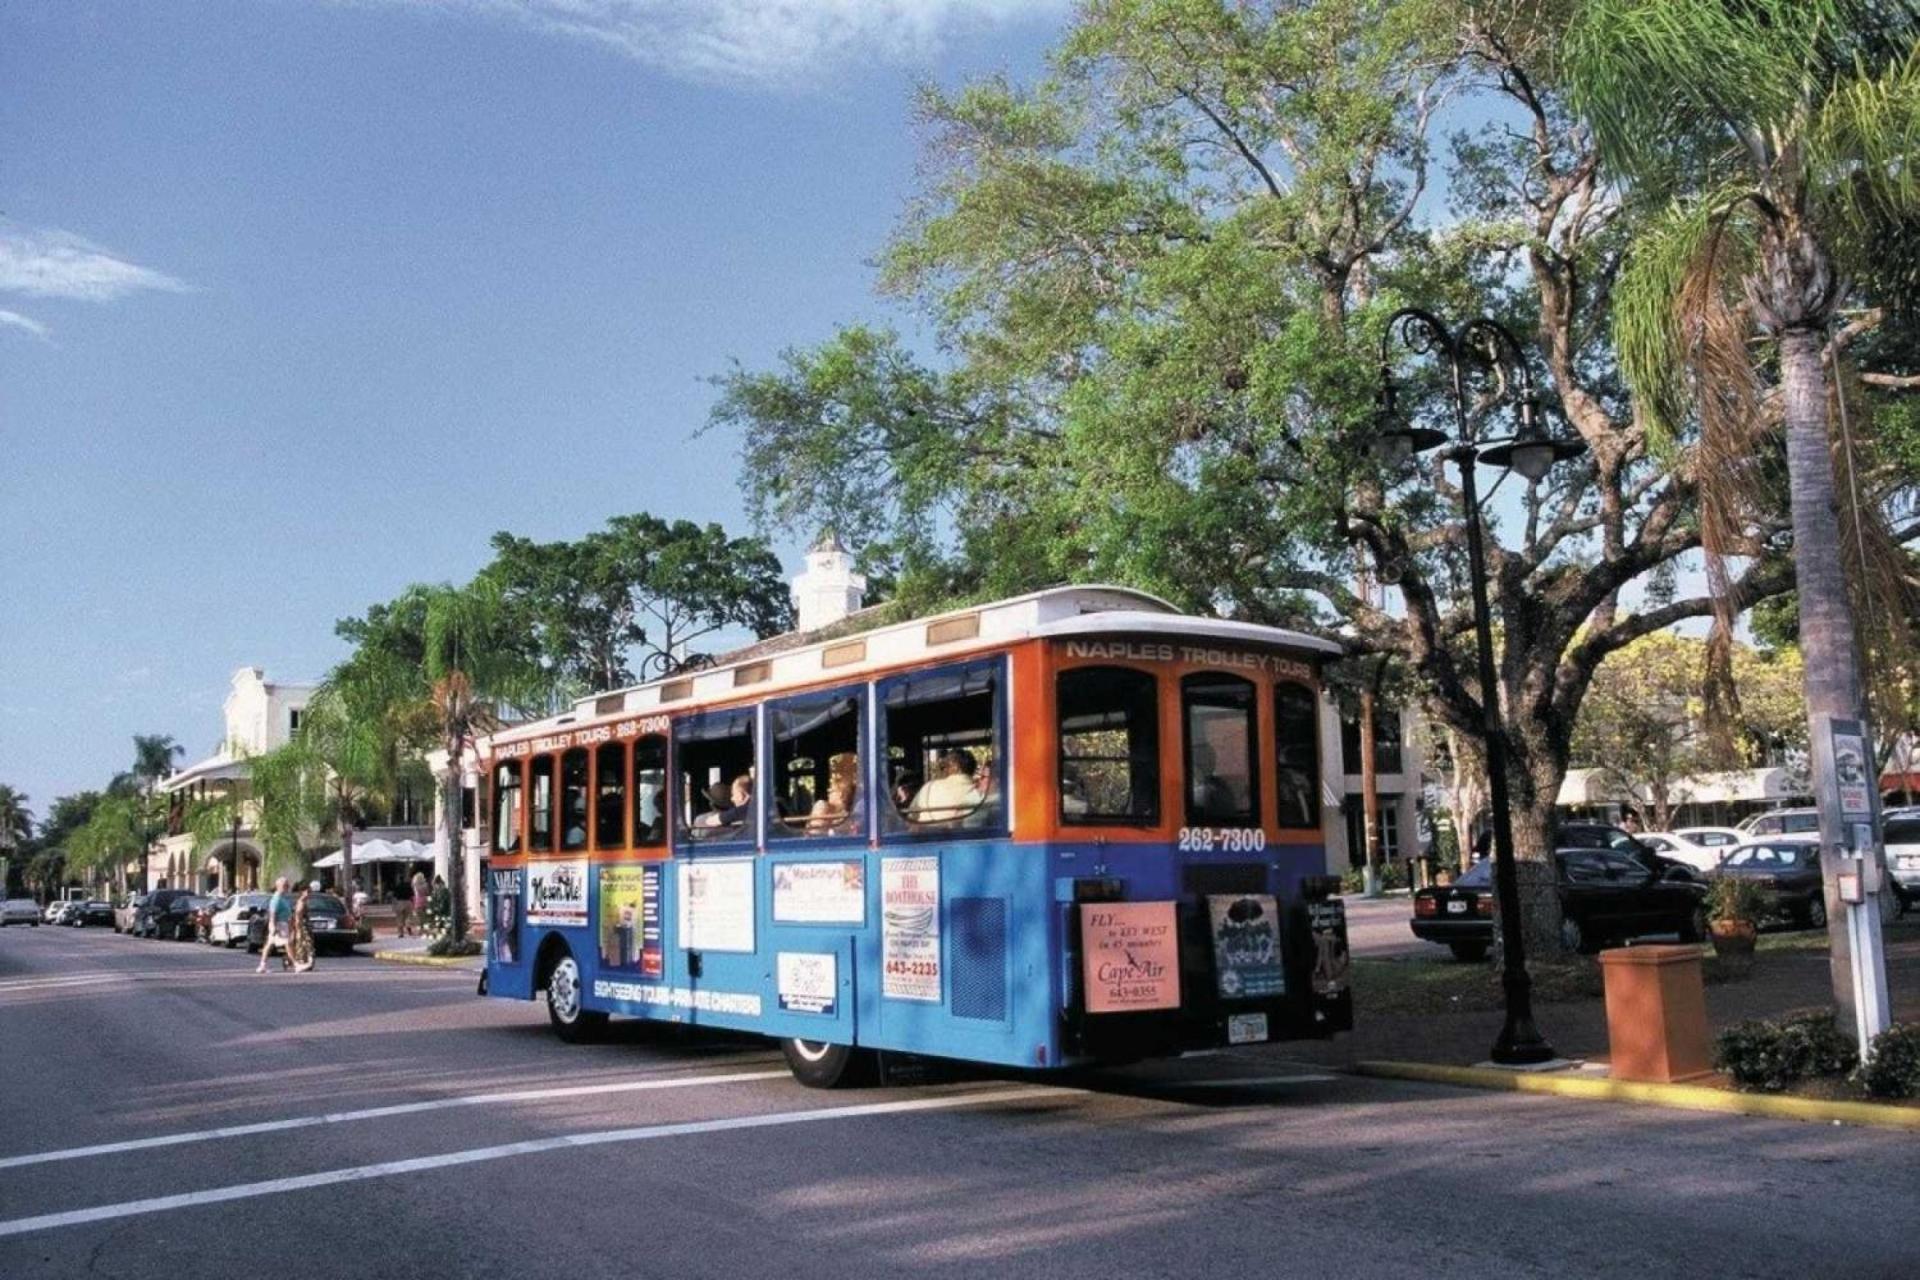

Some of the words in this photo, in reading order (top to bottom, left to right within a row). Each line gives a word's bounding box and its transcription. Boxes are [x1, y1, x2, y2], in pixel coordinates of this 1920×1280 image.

[1067, 641, 1174, 661] NAPLES
[1179, 646, 1269, 672] TROLLEY
[1272, 655, 1311, 680] TOURS
[495, 740, 530, 760] NAPLES
[531, 732, 572, 753] TROLLEY
[575, 725, 610, 744] TOURS
[616, 714, 670, 738] 262-7300
[1178, 826, 1266, 852] 262-7300
[886, 890, 936, 905] BOATHOUSE
[1120, 927, 1138, 937] KEY
[1142, 925, 1168, 936] WEST
[886, 960, 938, 976] 643-2235
[1098, 961, 1134, 987] Cape
[1138, 960, 1166, 978] Air
